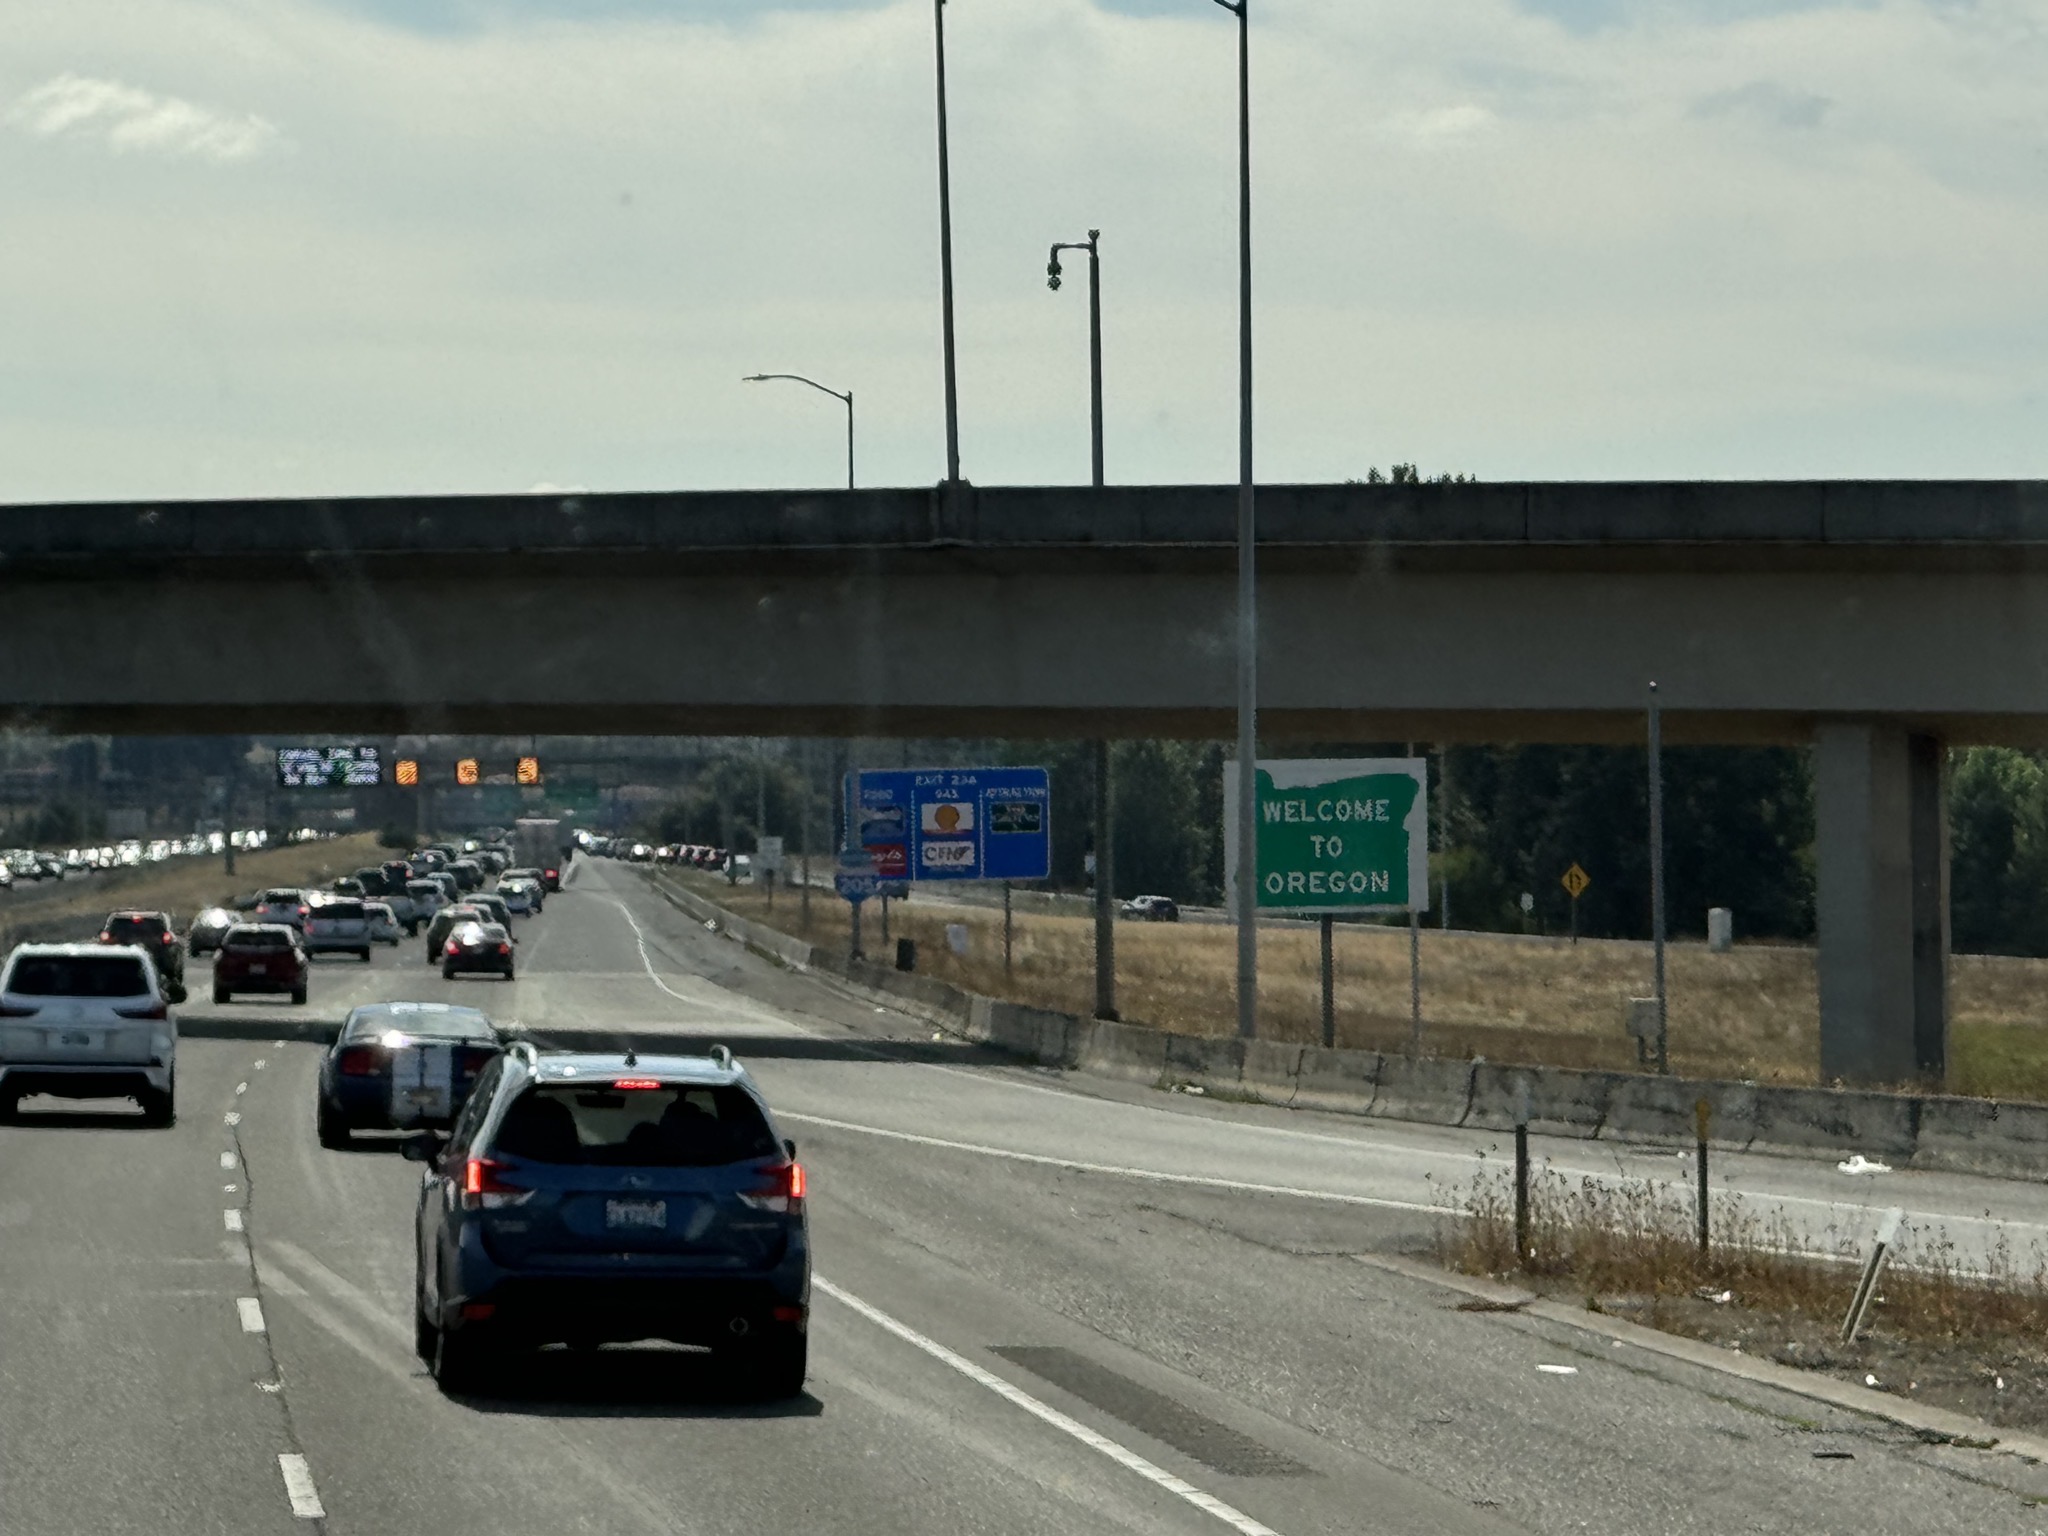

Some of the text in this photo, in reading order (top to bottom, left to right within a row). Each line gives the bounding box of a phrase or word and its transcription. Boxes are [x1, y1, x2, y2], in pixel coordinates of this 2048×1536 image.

[1263, 799, 1390, 823] WELCOME
[1310, 835, 1343, 858] TO
[1265, 870, 1389, 894] OREGON
